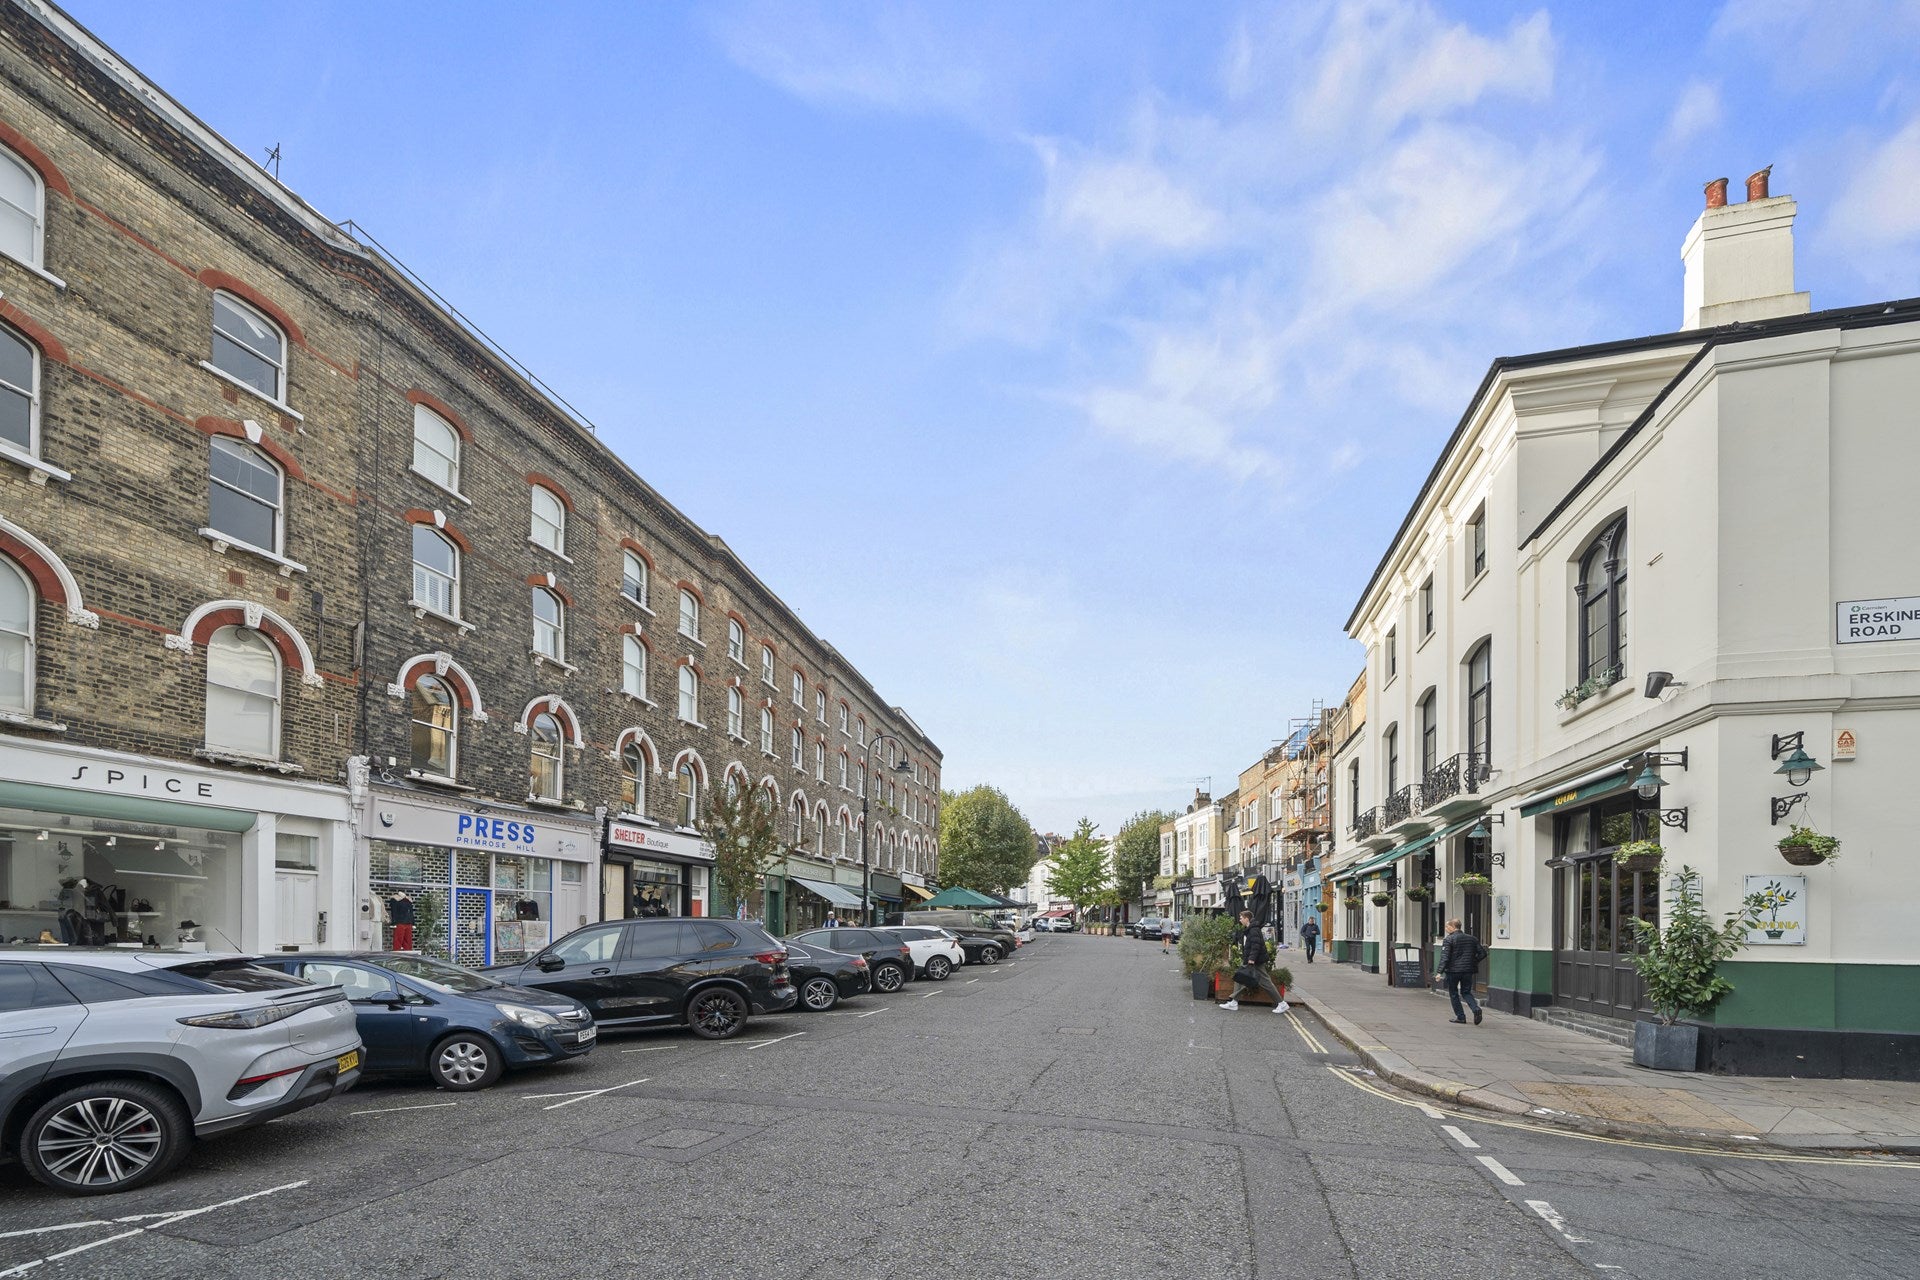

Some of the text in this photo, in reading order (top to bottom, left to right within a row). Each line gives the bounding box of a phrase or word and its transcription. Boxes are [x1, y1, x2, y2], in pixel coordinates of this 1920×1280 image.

[1849, 609, 1920, 624] ERSKINE
[1850, 624, 1902, 637] ROAD
[72, 766, 213, 797] SPICE
[458, 814, 535, 844] PRESS
[614, 828, 669, 849] SHELTER Boutique
[456, 836, 536, 853] PRIMROSE HILL
